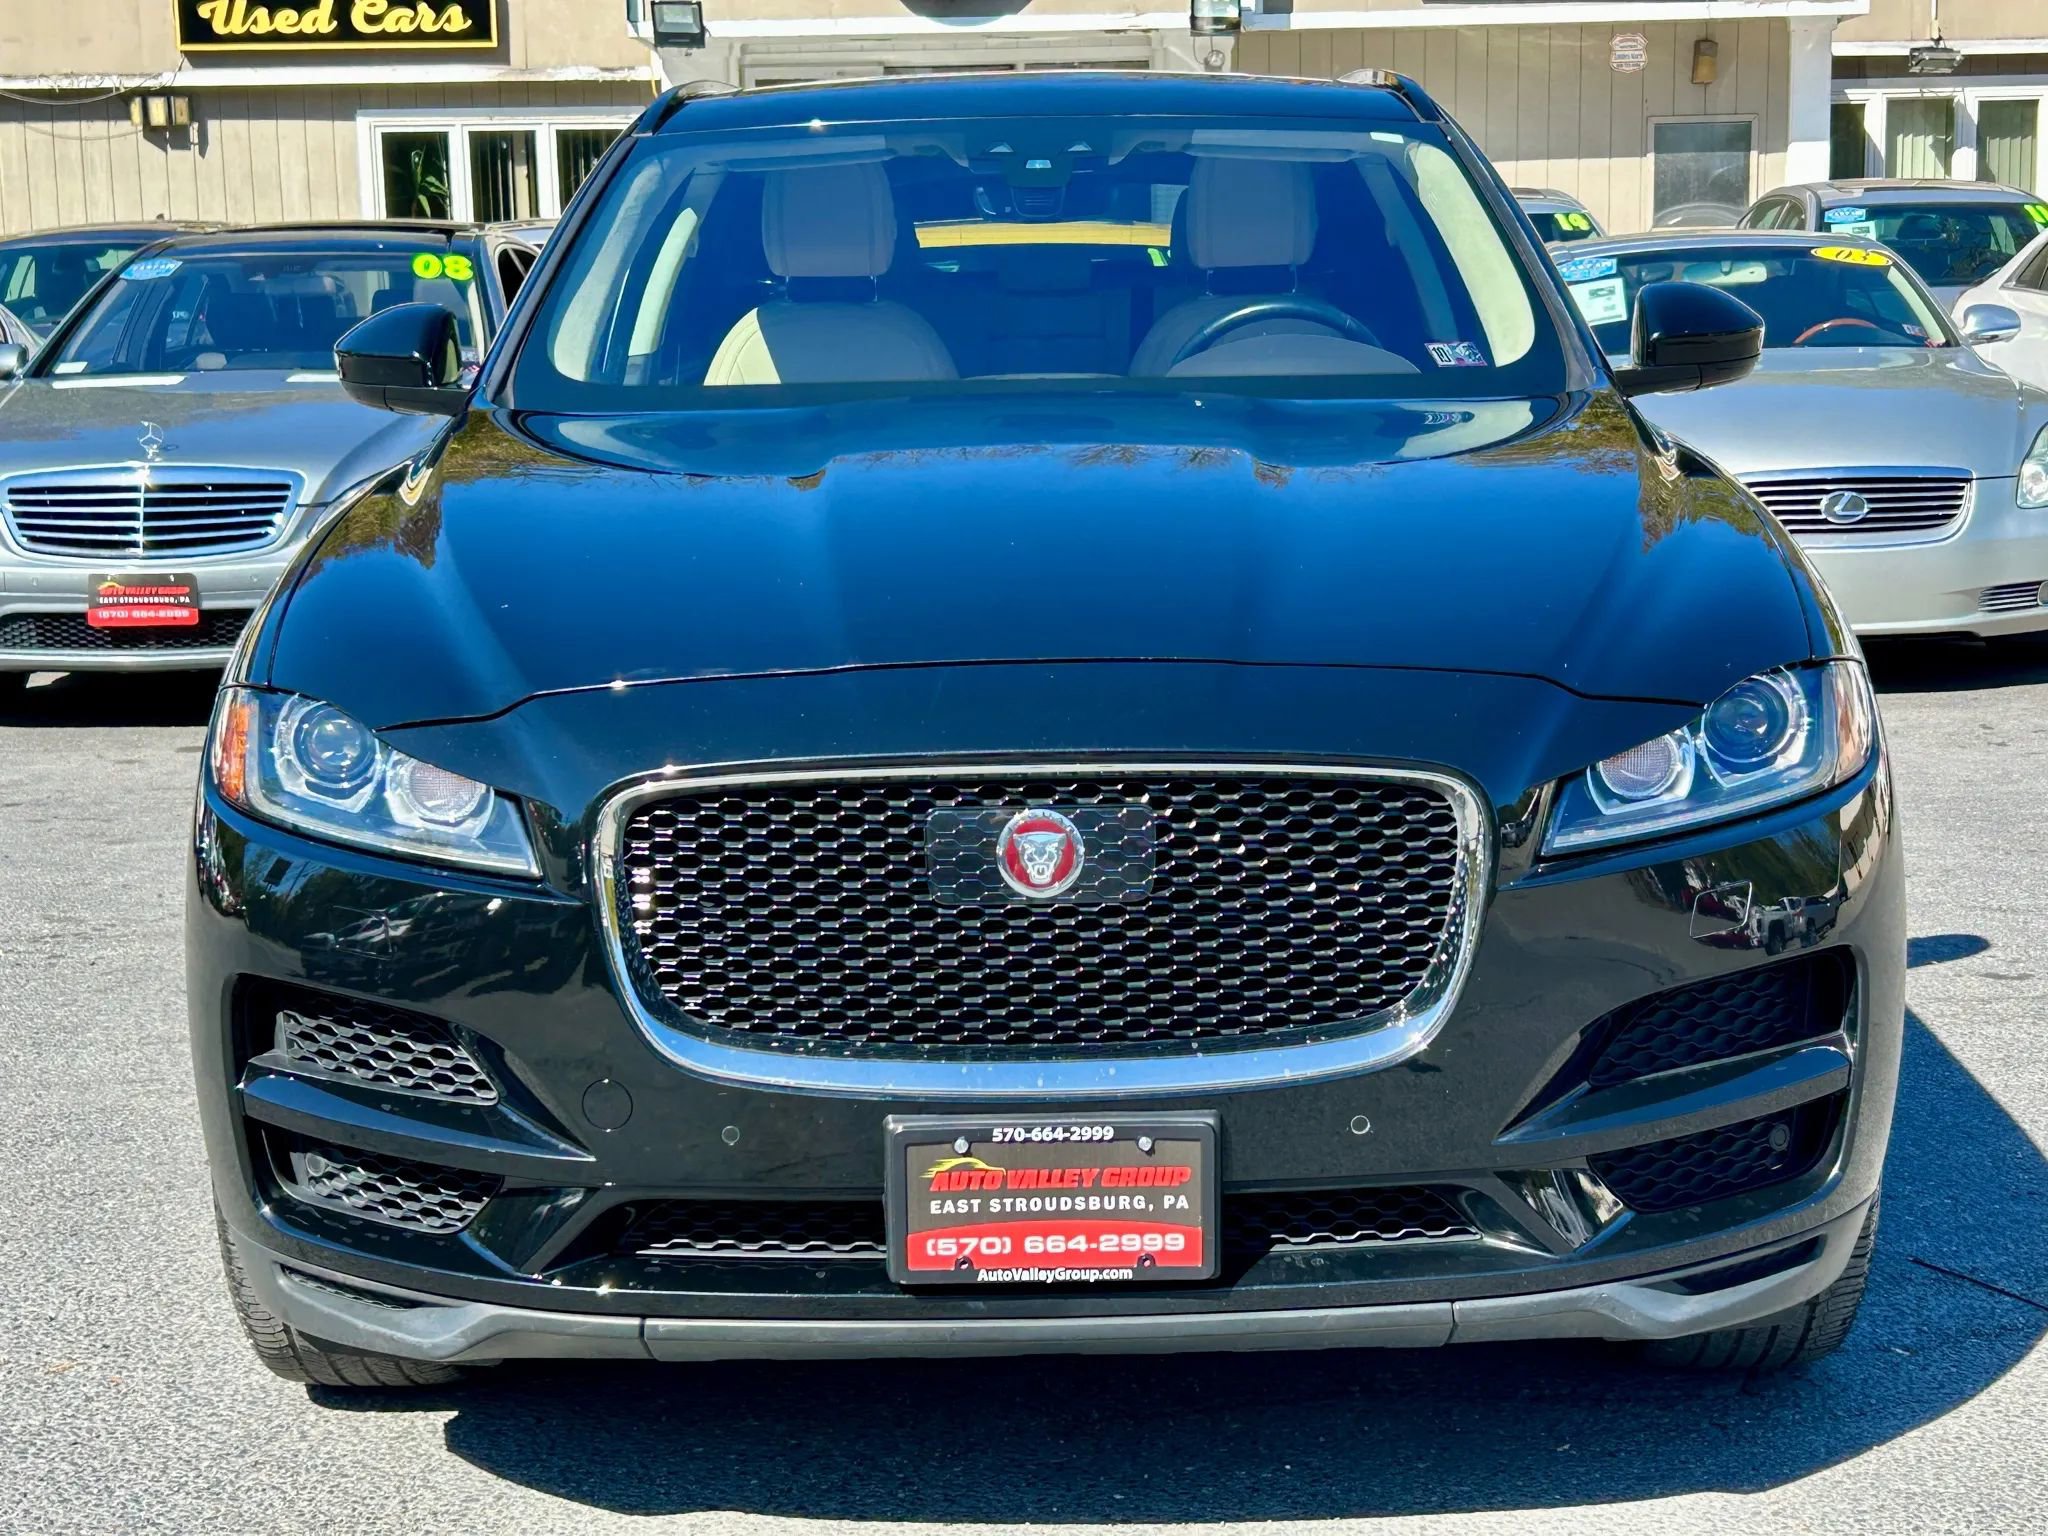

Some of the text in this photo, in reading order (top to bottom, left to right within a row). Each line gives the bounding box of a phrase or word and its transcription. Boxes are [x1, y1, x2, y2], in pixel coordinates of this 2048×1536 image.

[198, 0, 473, 35] Used Cars
[413, 254, 474, 280] 08
[992, 1126, 1115, 1143] 570-664-2999
[930, 1166, 1192, 1192] AUTO VALLEY GROUP
[930, 1195, 1190, 1214] EAST STROUDSBURG, PA
[926, 1233, 1186, 1257] (570) 664-2999
[977, 1267, 1133, 1283] AutoValleyGroup.com
